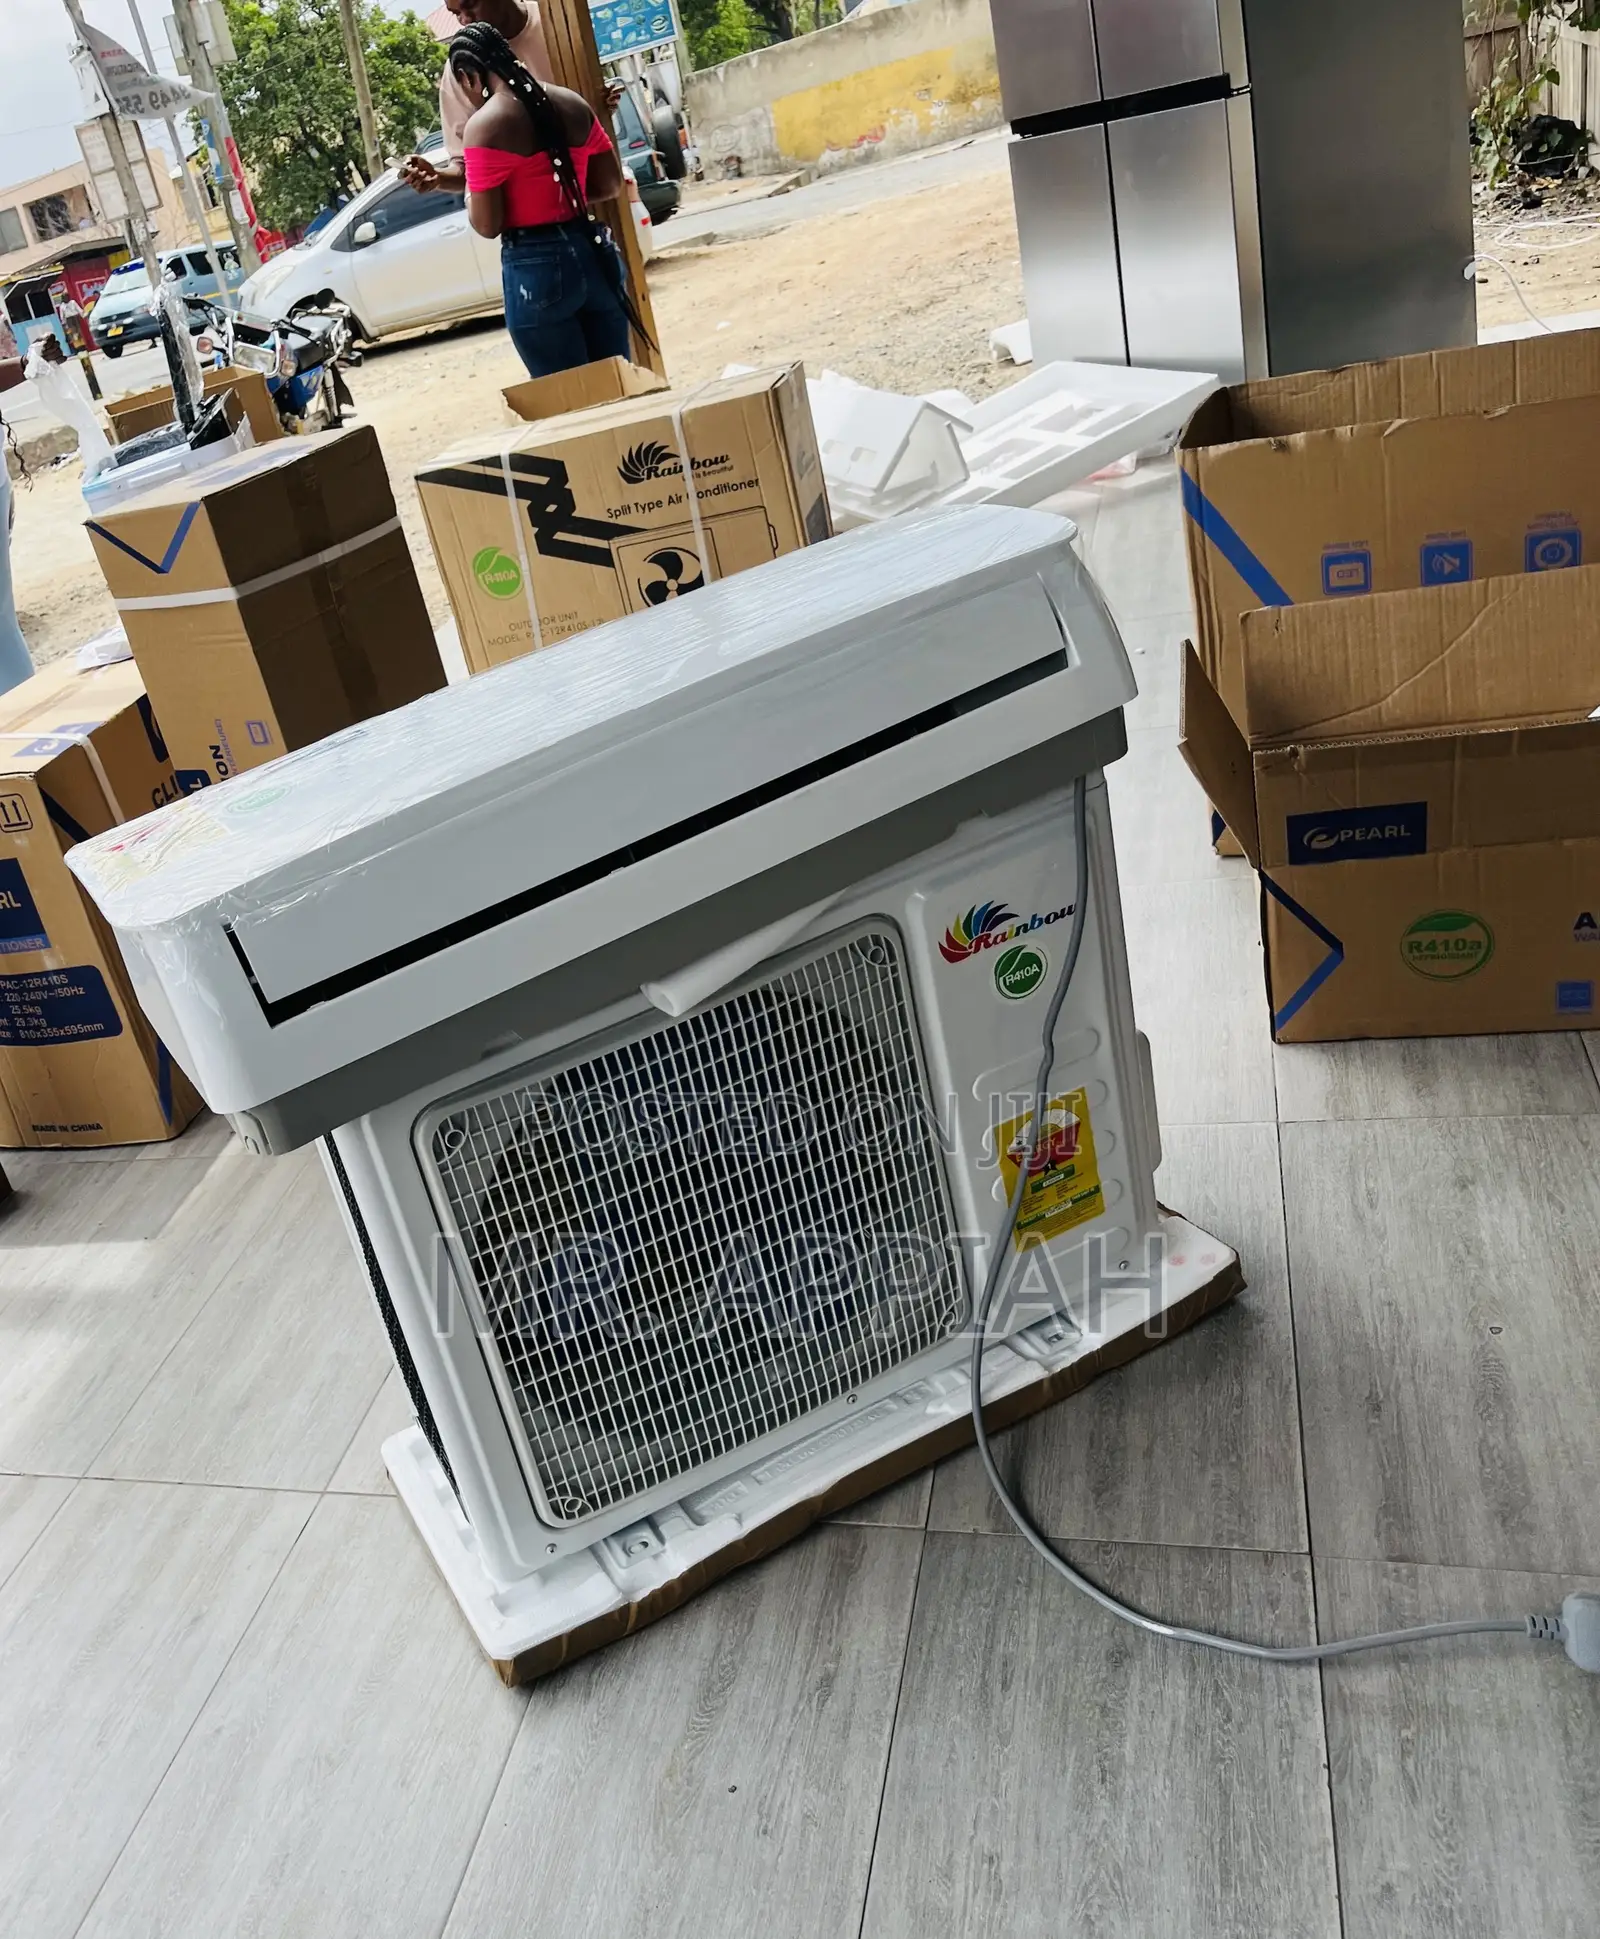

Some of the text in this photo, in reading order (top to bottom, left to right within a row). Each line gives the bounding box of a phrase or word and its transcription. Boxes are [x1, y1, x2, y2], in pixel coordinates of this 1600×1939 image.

[606, 503, 632, 520] Split
[633, 496, 664, 515] Type
[667, 492, 684, 507] Air
[1339, 824, 1412, 842] PEARL
[967, 903, 1078, 954] Rainbow
[1407, 935, 1483, 955] R410a
[1005, 964, 1041, 986] R410A
[19, 1022, 104, 1040] 810x355x595mm
[58, 1124, 69, 1133] IN
[70, 1122, 104, 1133] CHINA
